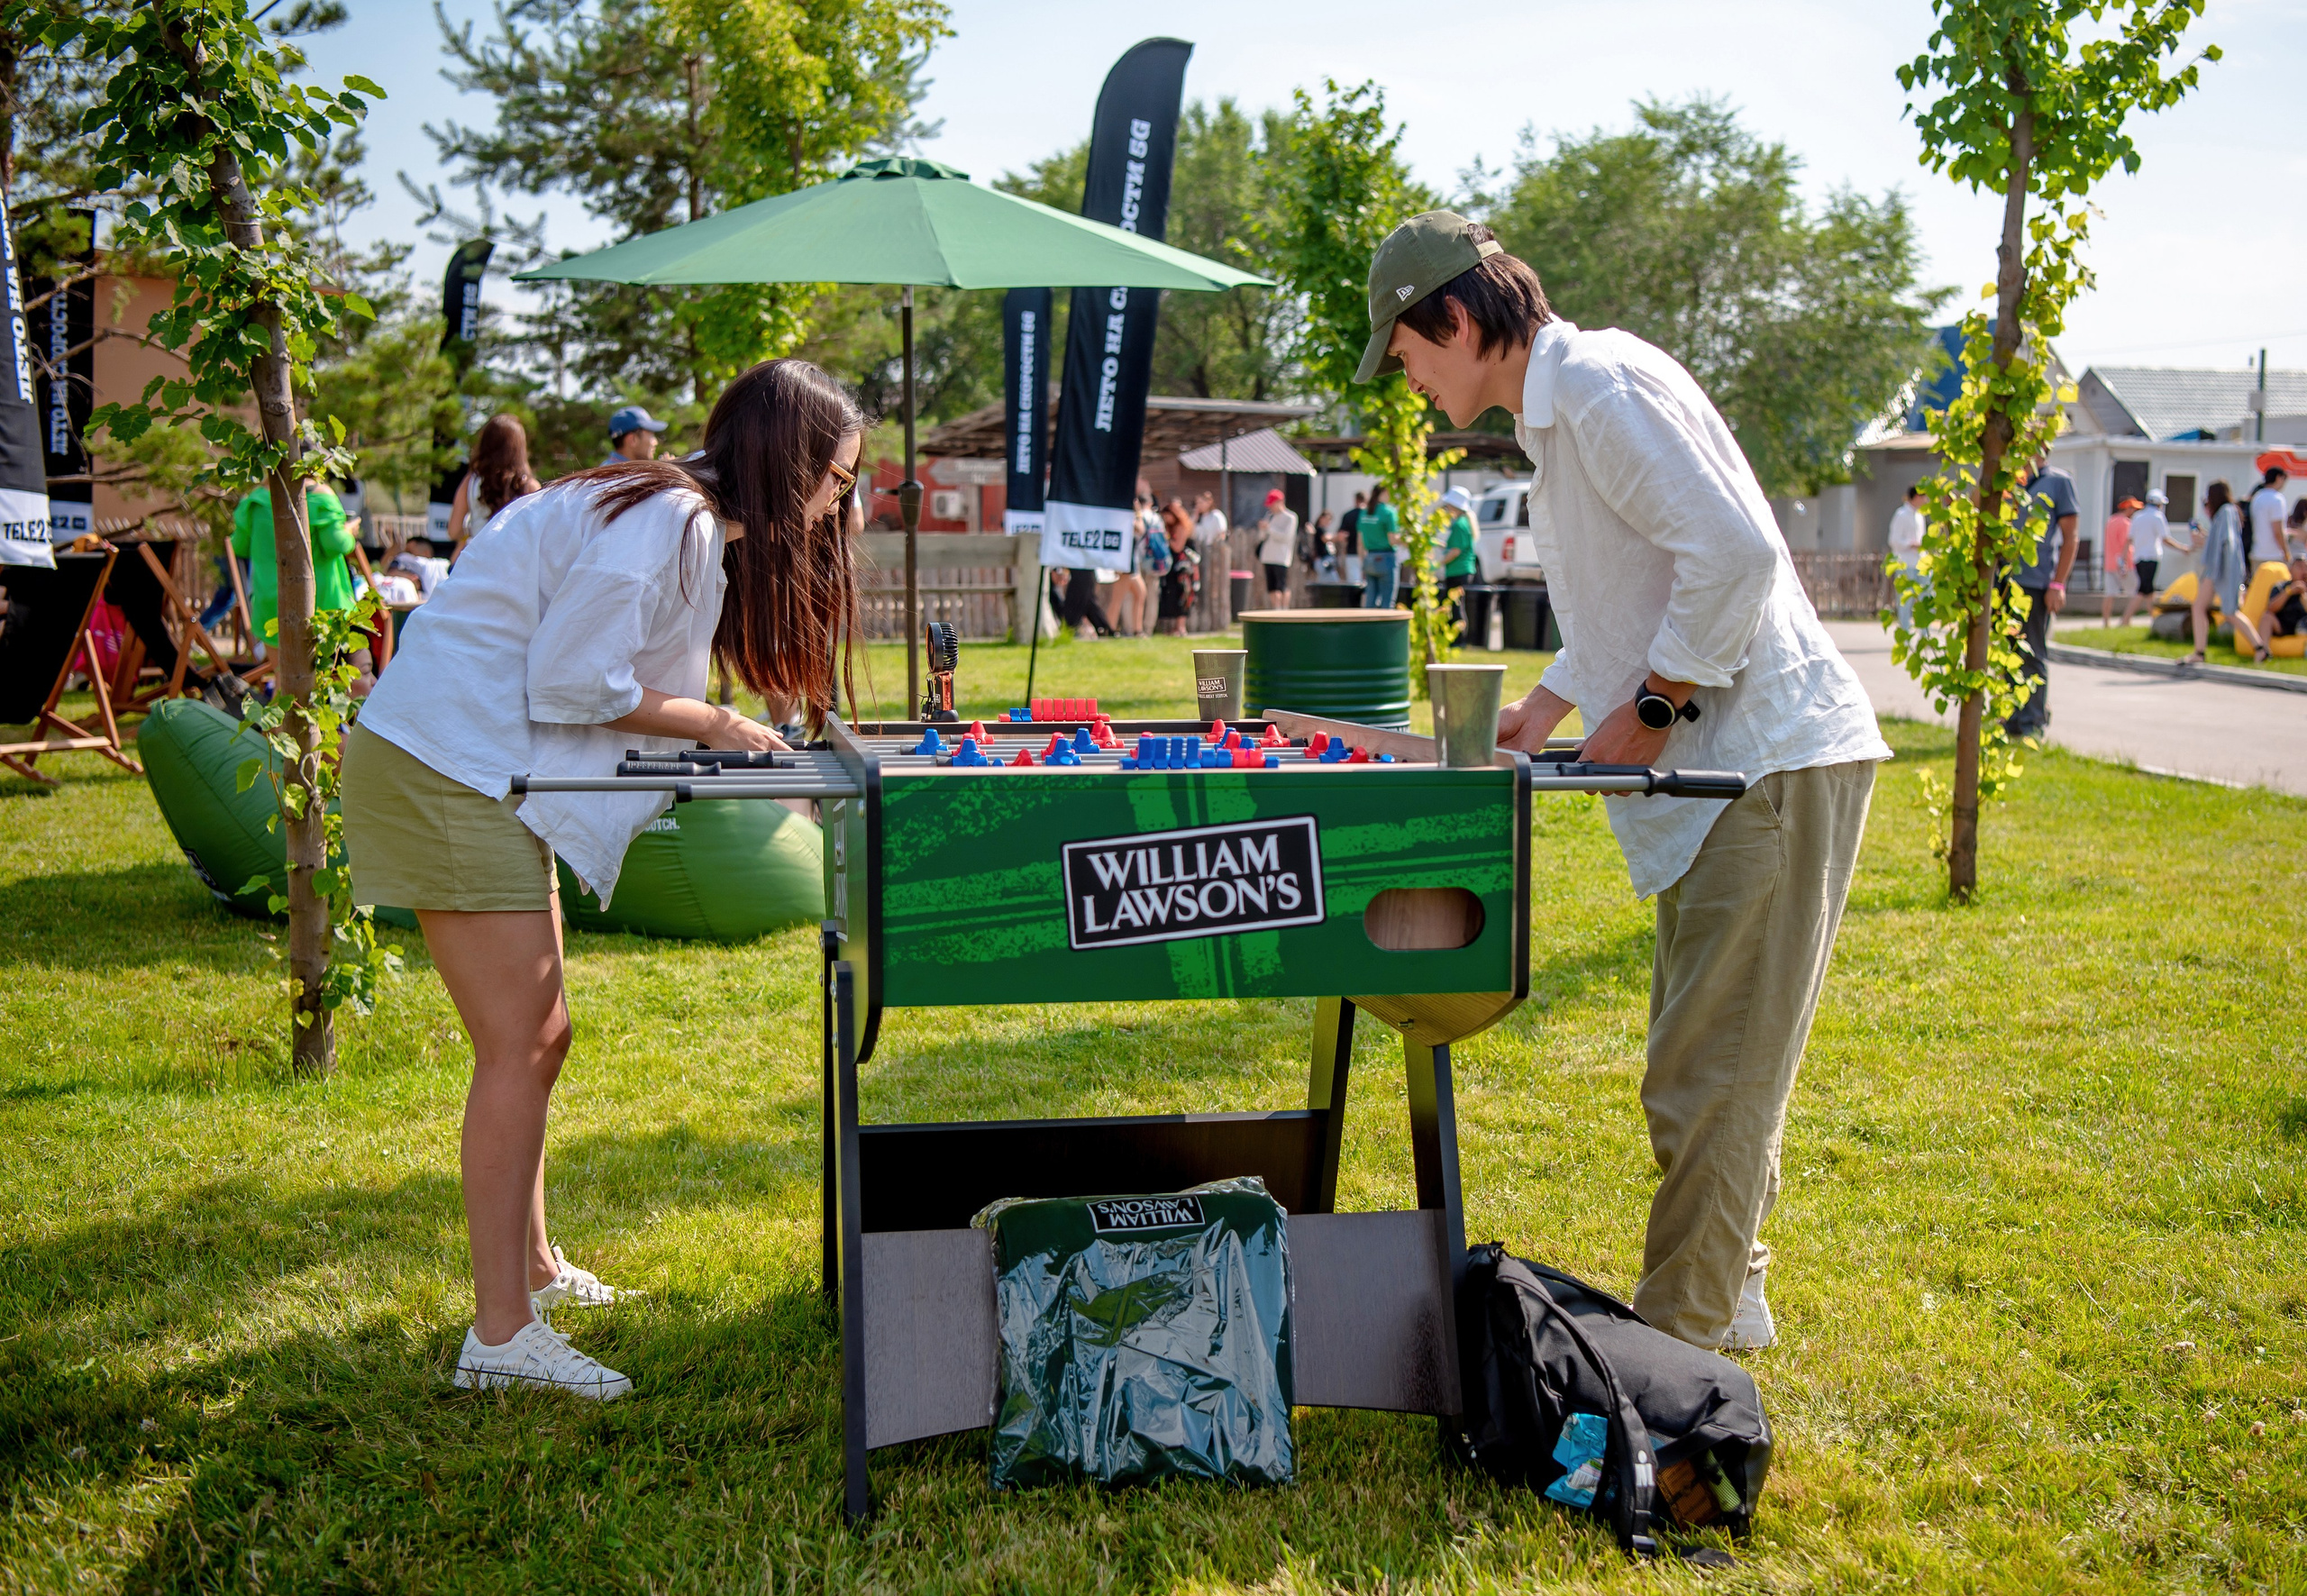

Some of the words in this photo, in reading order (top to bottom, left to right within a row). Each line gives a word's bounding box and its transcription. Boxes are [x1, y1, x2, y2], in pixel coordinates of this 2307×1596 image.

[1128, 118, 1151, 159] 5G
[5, 266, 23, 313] НА
[1105, 314, 1125, 354] НА
[11, 315, 34, 404] ЛЕТО
[1095, 356, 1119, 432] ЛЕТО
[3, 519, 46, 543] TELE2
[1062, 530, 1100, 549] TELE2
[1087, 834, 1281, 890] WILLIAM
[1082, 872, 1302, 934] LAWSON'S
[1098, 1197, 1194, 1213] LAWSON'S
[1108, 1208, 1195, 1227] WILLIAM
